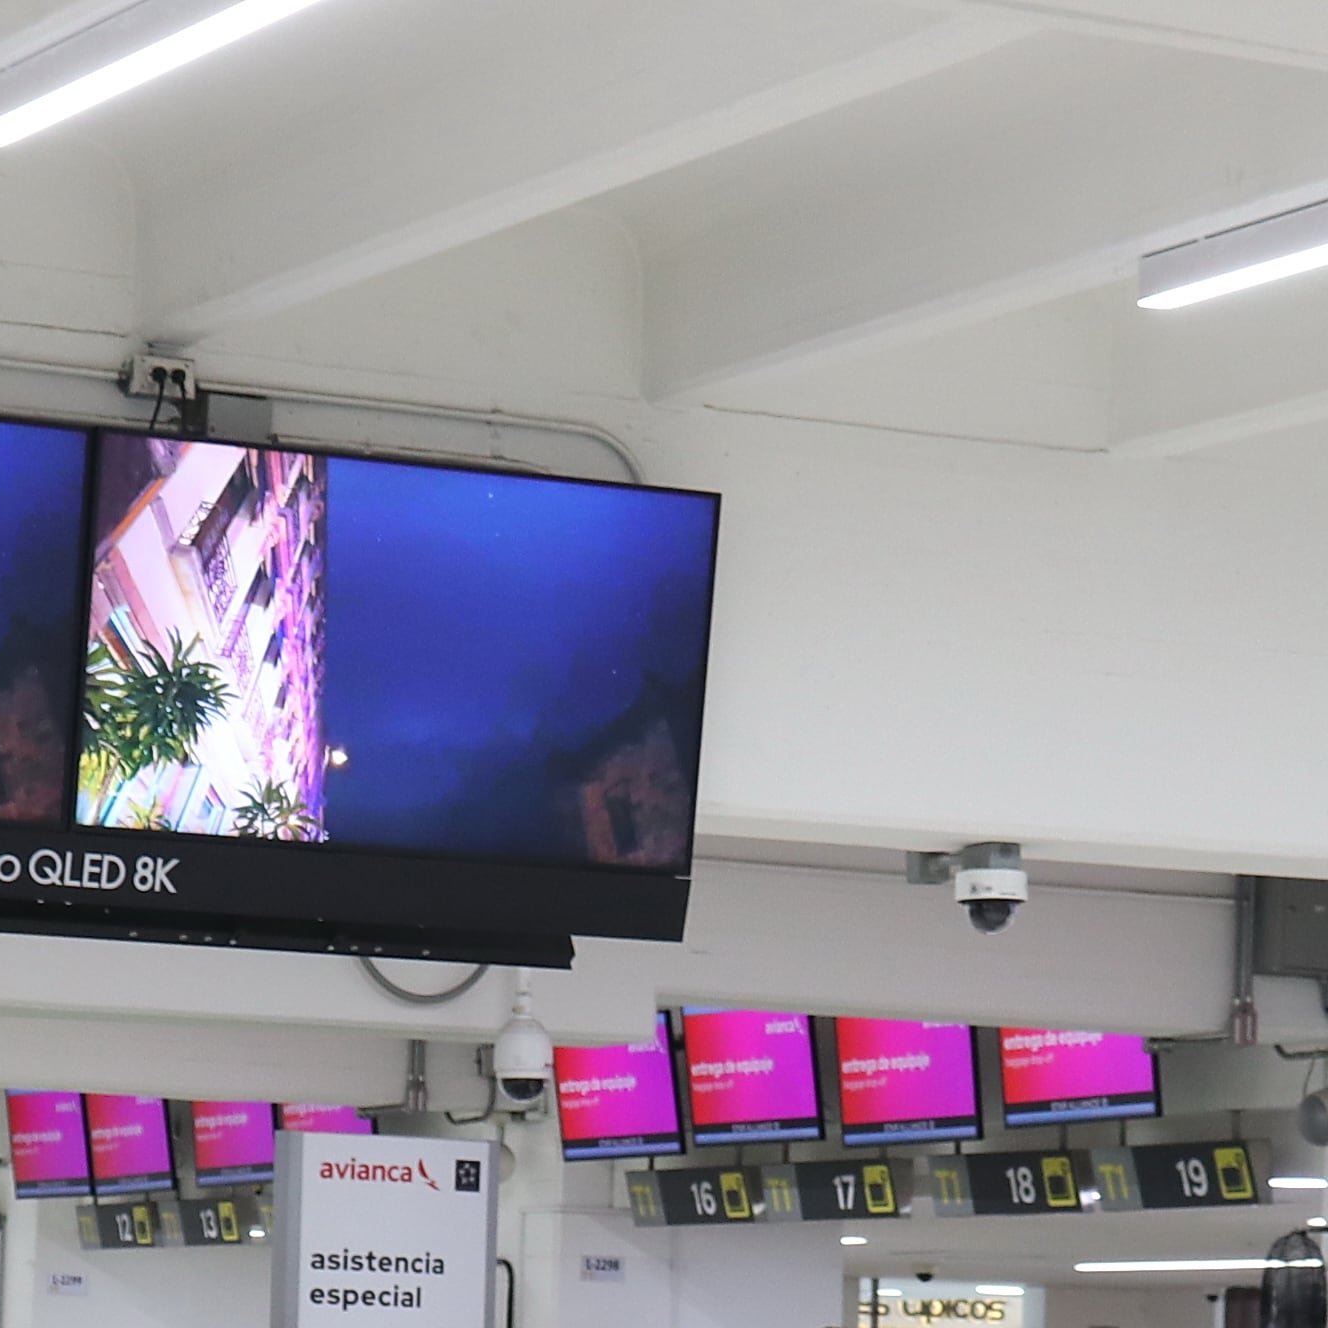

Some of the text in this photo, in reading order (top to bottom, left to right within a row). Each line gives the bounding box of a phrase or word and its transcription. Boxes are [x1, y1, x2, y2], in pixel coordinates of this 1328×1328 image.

[28, 848, 126, 890] QLED
[133, 855, 180, 894] 8K
[320, 1158, 412, 1182] avianca
[936, 1166, 1036, 1206] T1 18
[1098, 1158, 1209, 1200] T1 19
[631, 1181, 717, 1217] T1 16
[768, 1175, 856, 1213] T1 17
[115, 1213, 133, 1241] 12
[200, 1208, 218, 1239] 13
[310, 1248, 444, 1275] asistencia
[309, 1285, 422, 1311] especial
